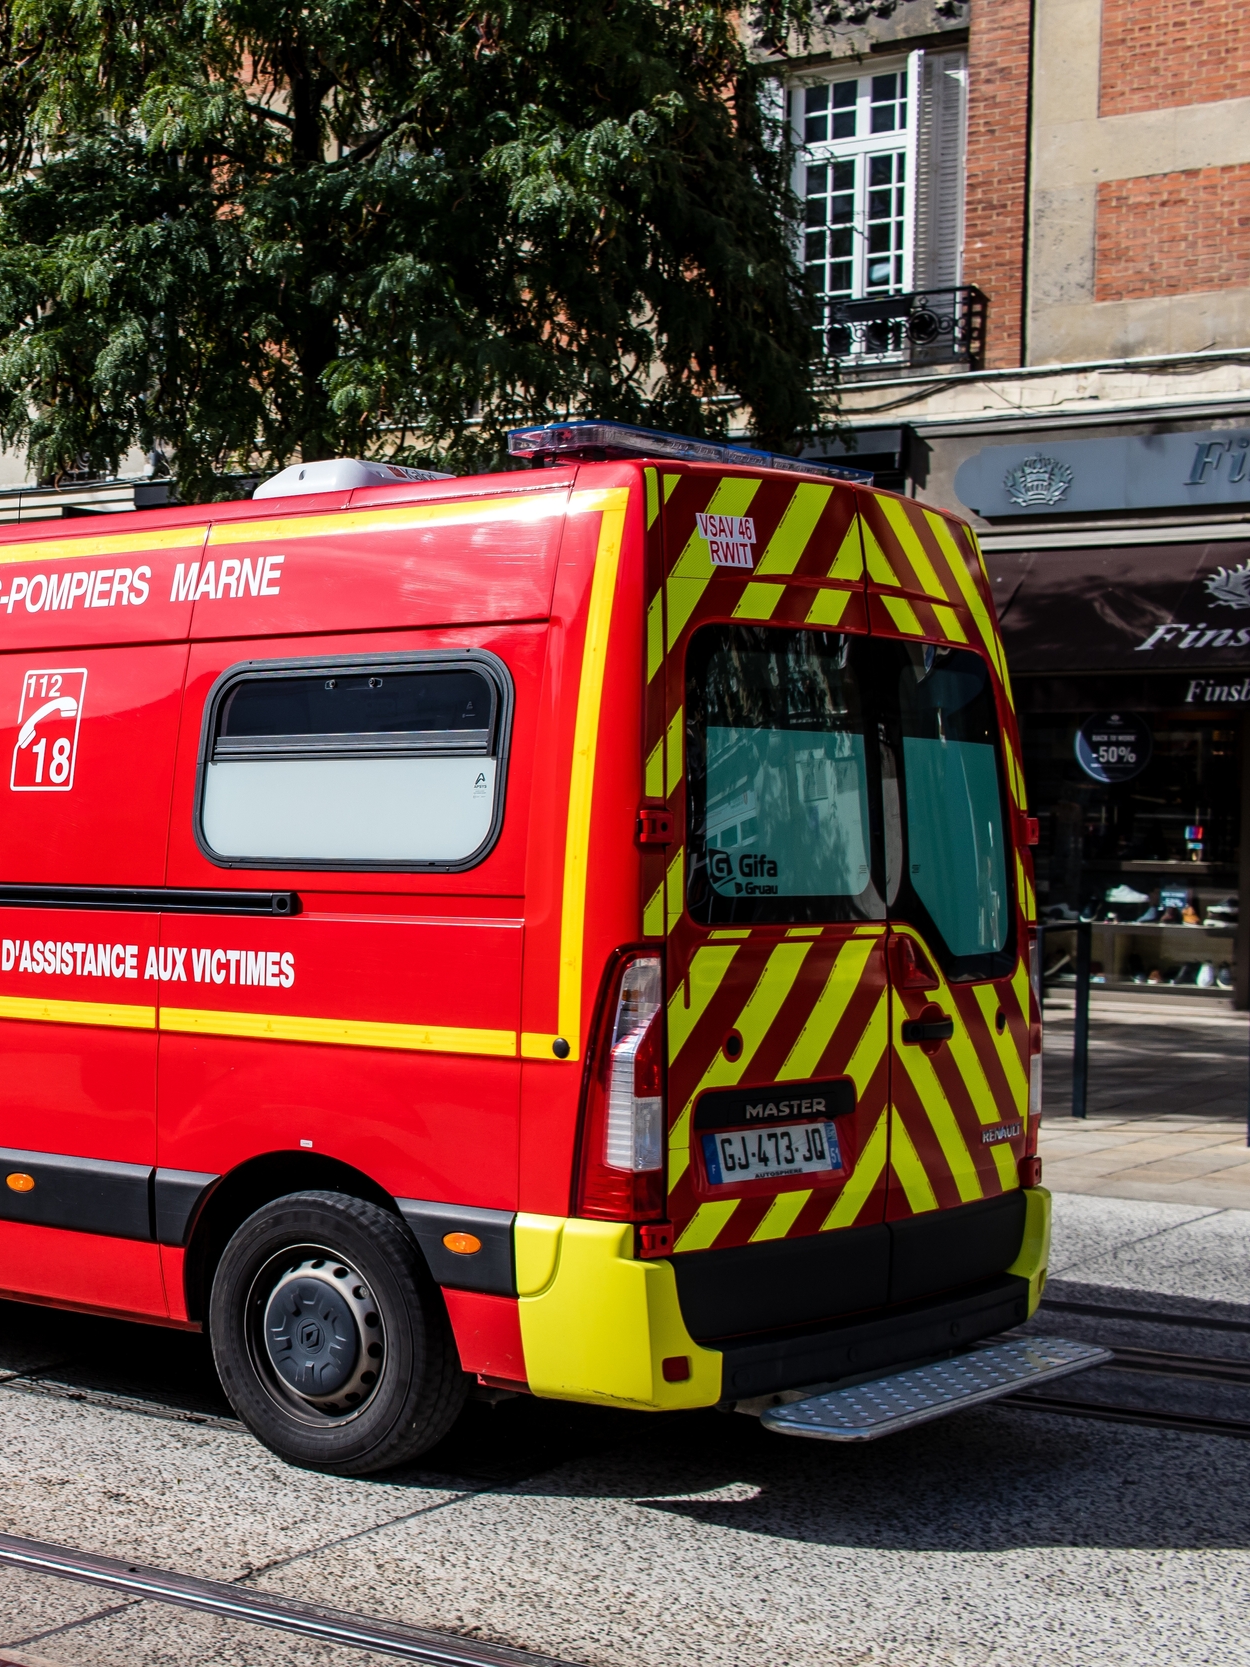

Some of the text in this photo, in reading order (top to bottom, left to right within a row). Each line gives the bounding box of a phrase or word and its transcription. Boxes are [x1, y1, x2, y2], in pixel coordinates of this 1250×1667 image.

[1183, 438, 1250, 485] Fi
[699, 514, 753, 540] VSAV 46
[709, 540, 748, 565] RWIT
[170, 555, 285, 603] MARNE
[28, 675, 63, 698] 112
[32, 737, 71, 784] 18
[1091, 746, 1136, 763] -50%
[739, 854, 778, 877] Gifa
[745, 882, 778, 894] Gruau
[1, 939, 138, 978] D'ASSISTANCE
[144, 946, 187, 982] AUX
[191, 948, 295, 988] VICTIMES
[745, 1098, 826, 1119] MASTER
[982, 1122, 1021, 1143] RENAULT
[830, 1147, 841, 1163] 51
[754, 1168, 803, 1179] AUTOSPHERE
